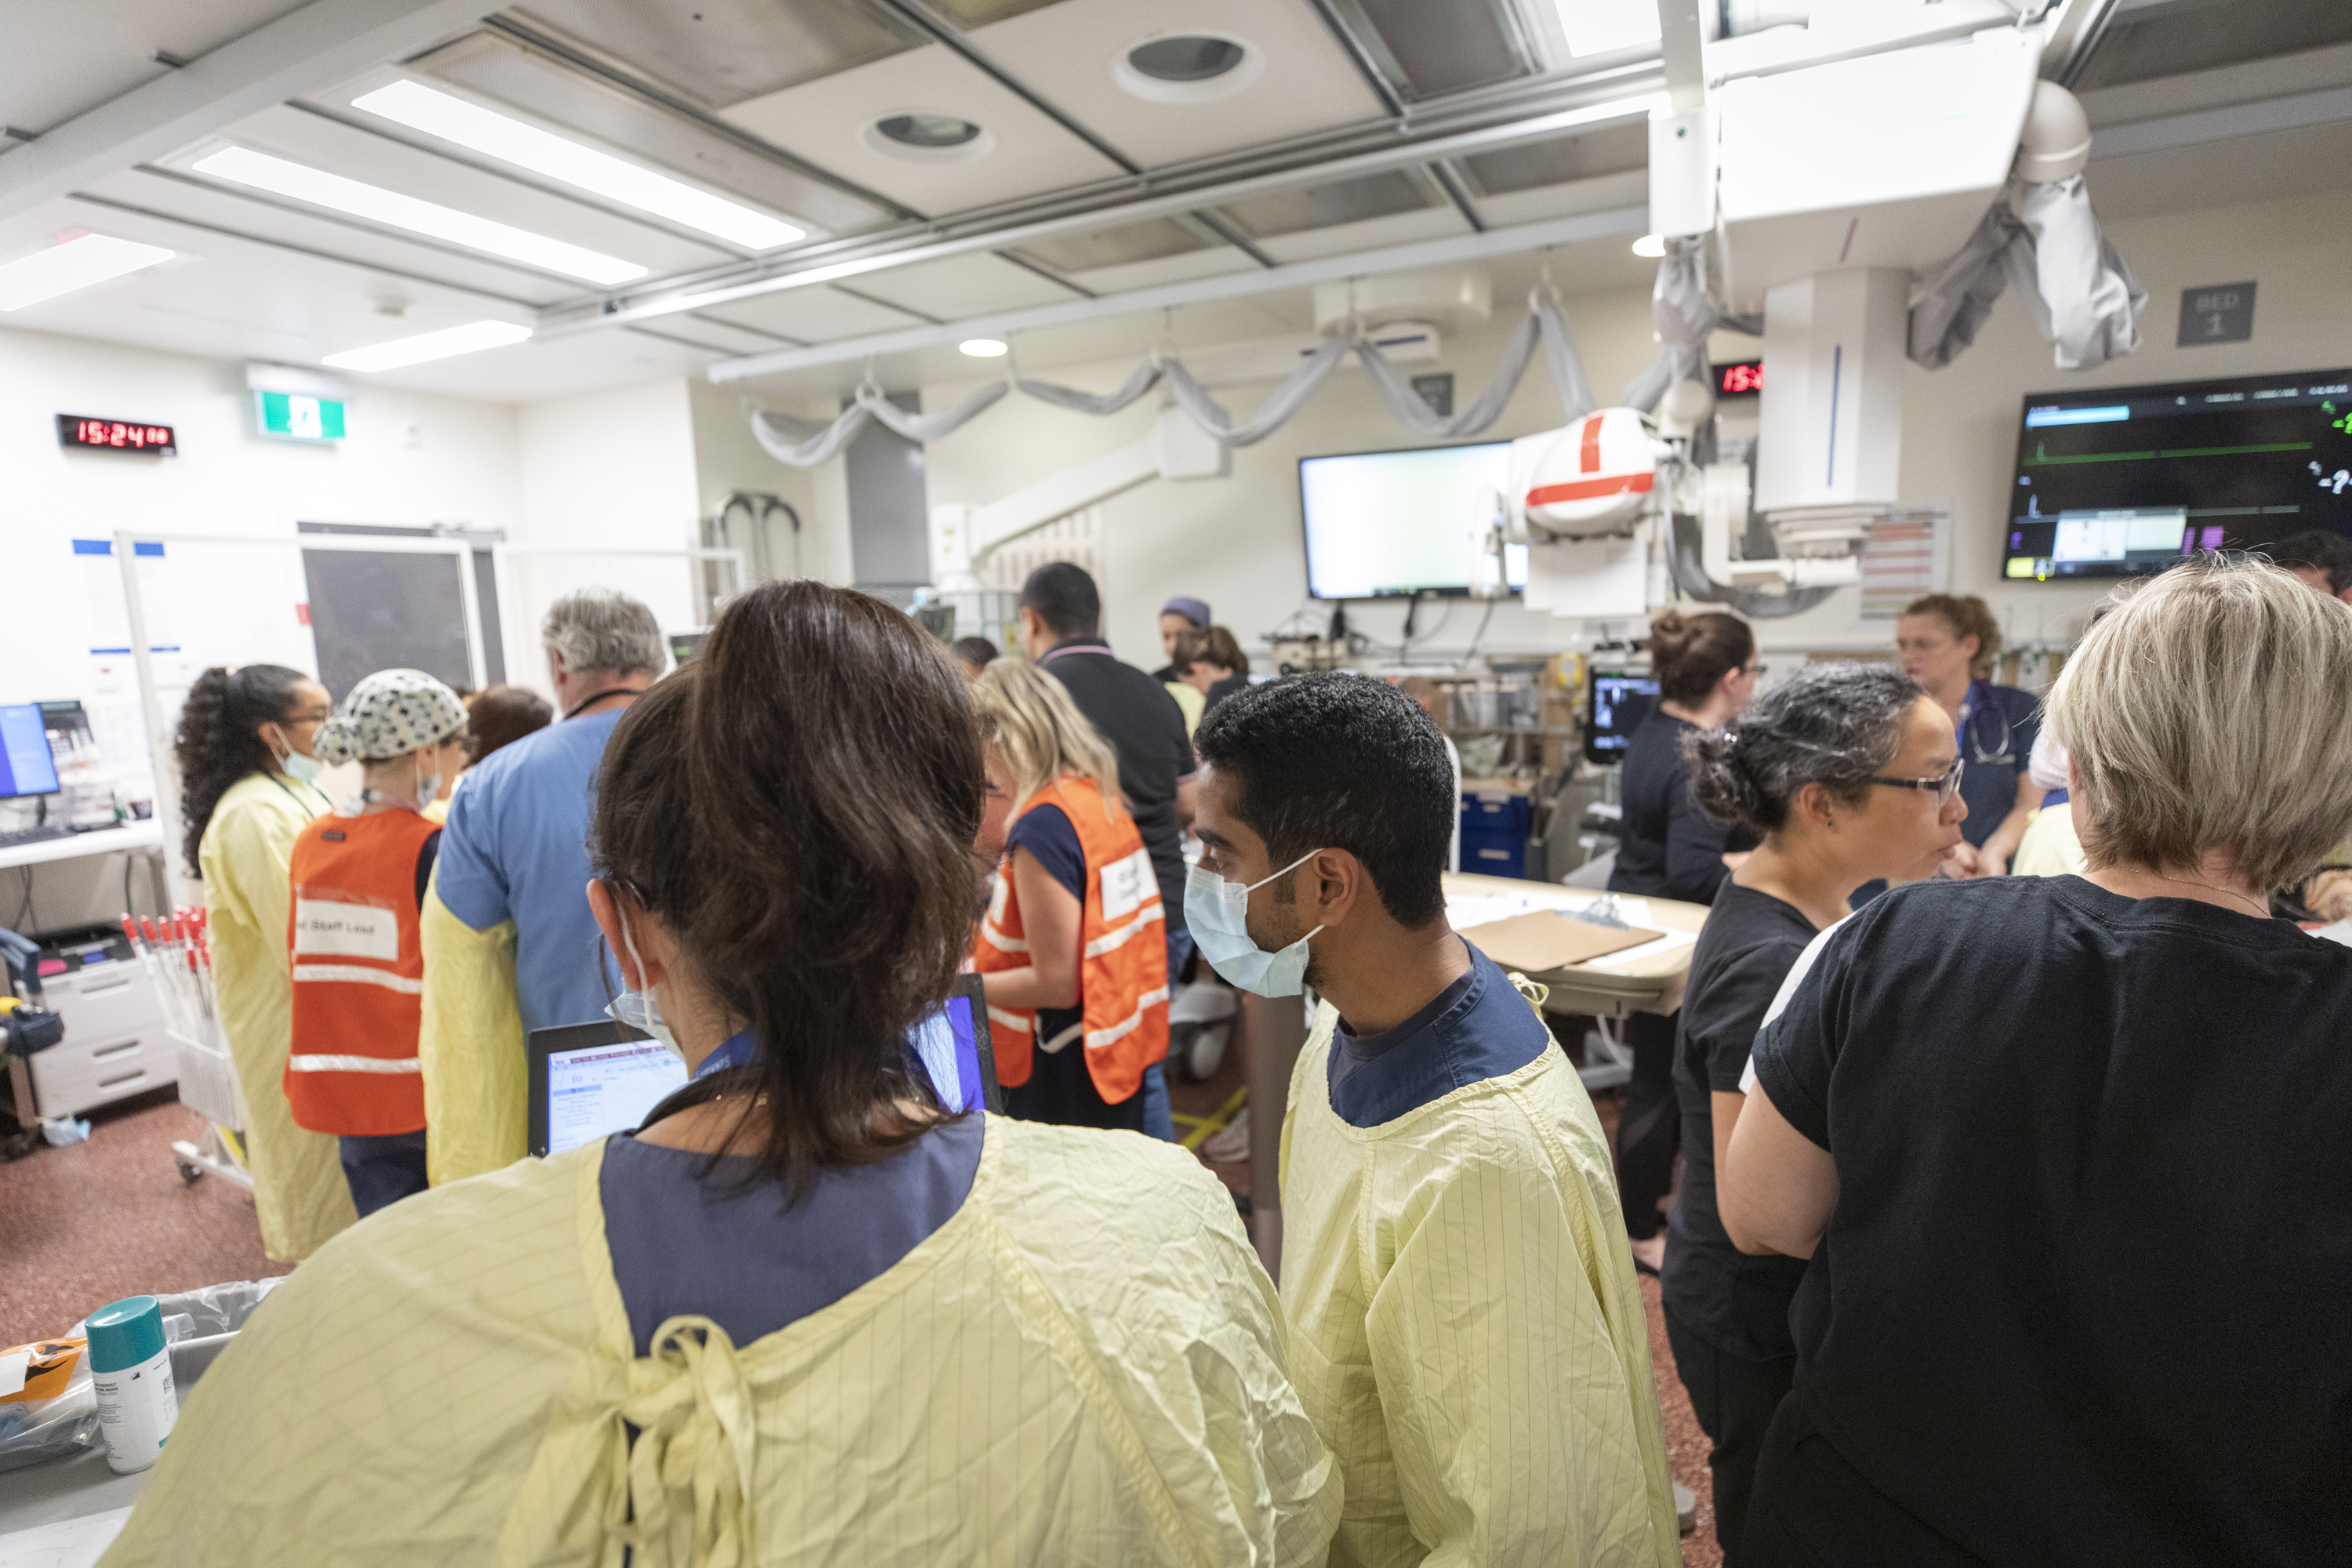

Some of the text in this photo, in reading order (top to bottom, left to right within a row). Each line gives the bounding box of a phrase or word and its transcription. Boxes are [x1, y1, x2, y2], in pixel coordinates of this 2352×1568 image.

[2196, 292, 2240, 313] BED
[2205, 313, 2224, 336] 1
[78, 420, 144, 448] 15:24
[310, 919, 343, 931] Staff
